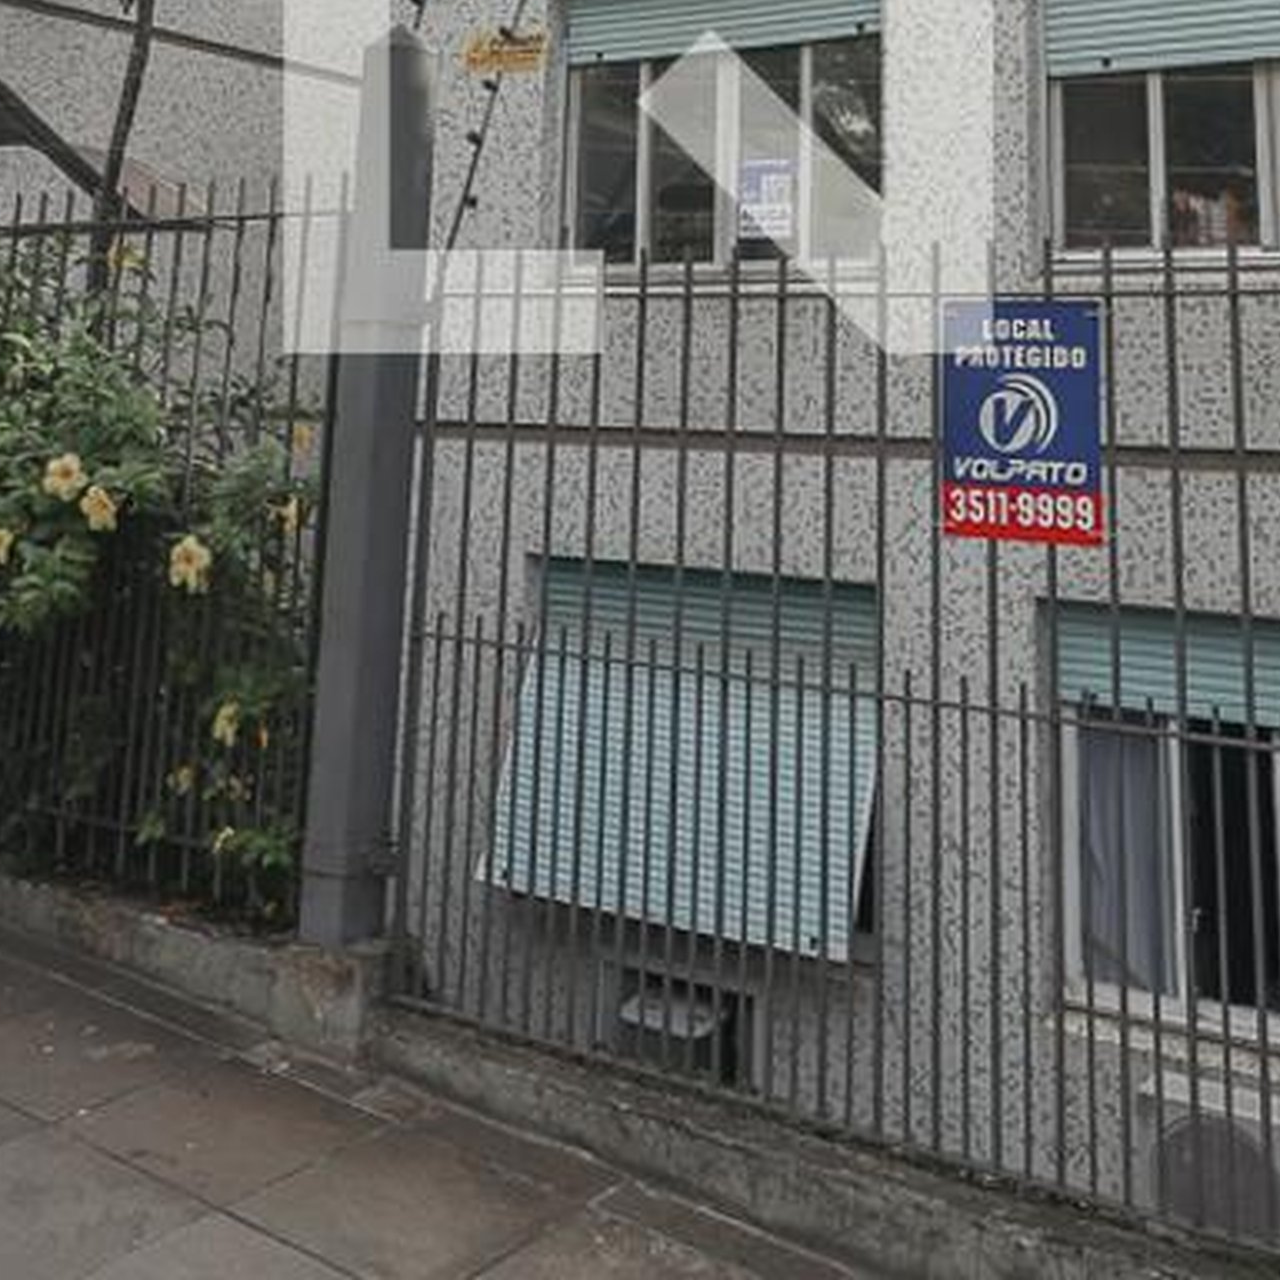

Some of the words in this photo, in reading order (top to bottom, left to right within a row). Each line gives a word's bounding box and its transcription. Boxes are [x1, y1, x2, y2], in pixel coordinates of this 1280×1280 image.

[981, 318, 1055, 341] LOCAL
[954, 345, 1087, 368] PROTEGIDO
[953, 456, 1088, 485] VOLPATO
[949, 488, 1095, 531] 3511-9999
